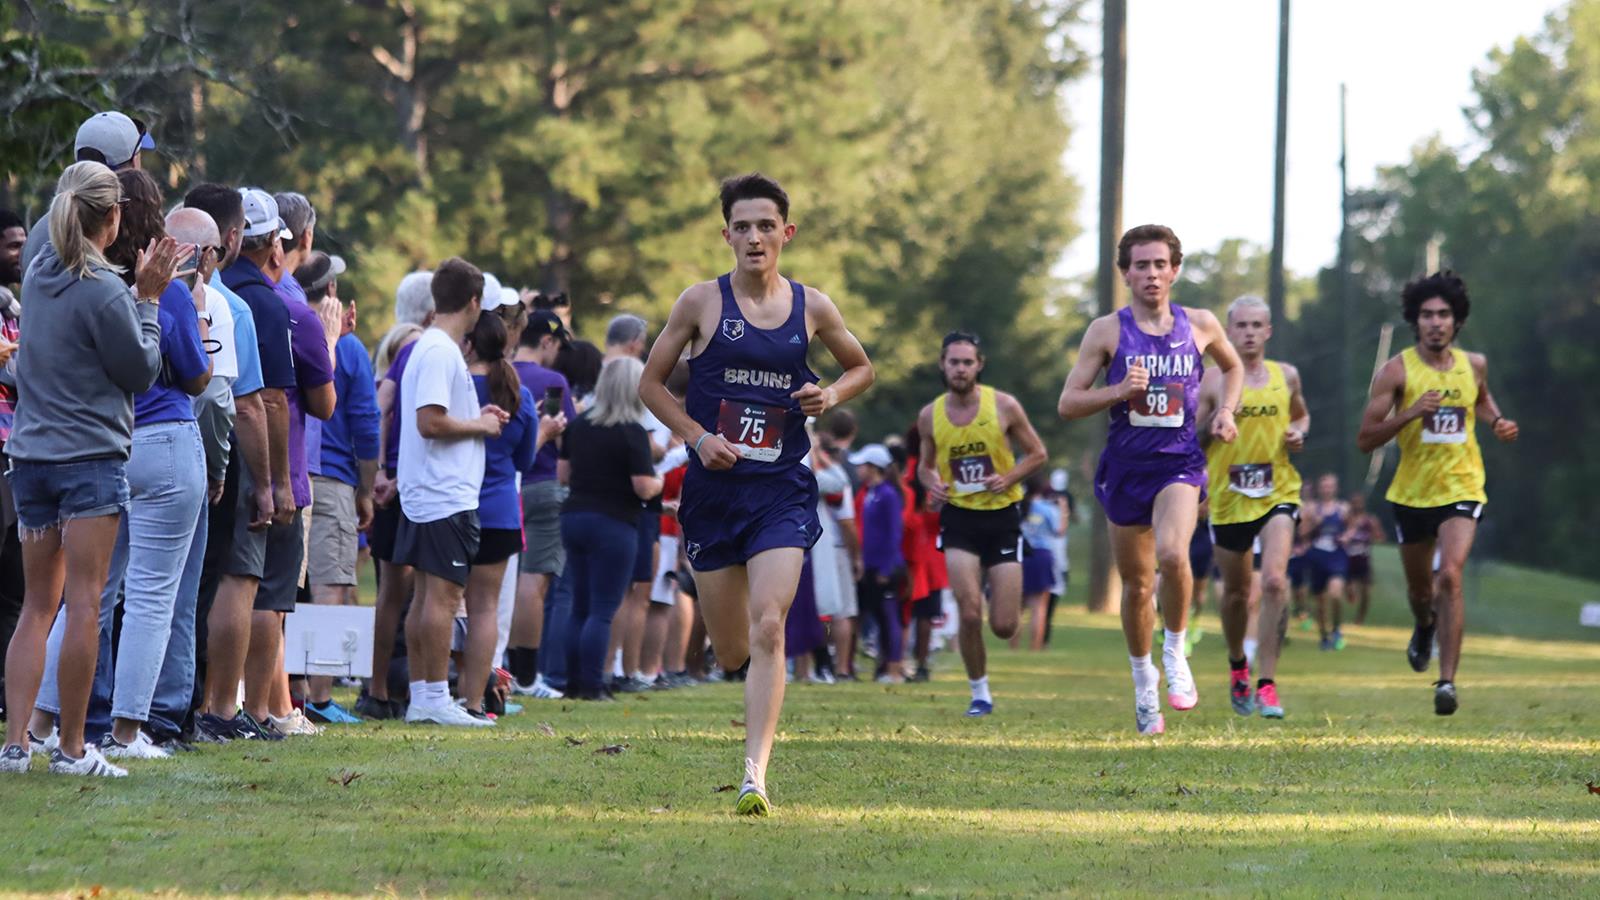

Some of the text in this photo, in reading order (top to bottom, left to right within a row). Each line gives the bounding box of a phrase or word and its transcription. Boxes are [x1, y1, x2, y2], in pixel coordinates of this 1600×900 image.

[724, 368, 791, 389] BRUINS
[1146, 393, 1168, 414] 98
[1241, 405, 1278, 417] SCAD
[739, 416, 766, 444] 75
[1432, 413, 1459, 433] 123
[960, 464, 985, 482] 122
